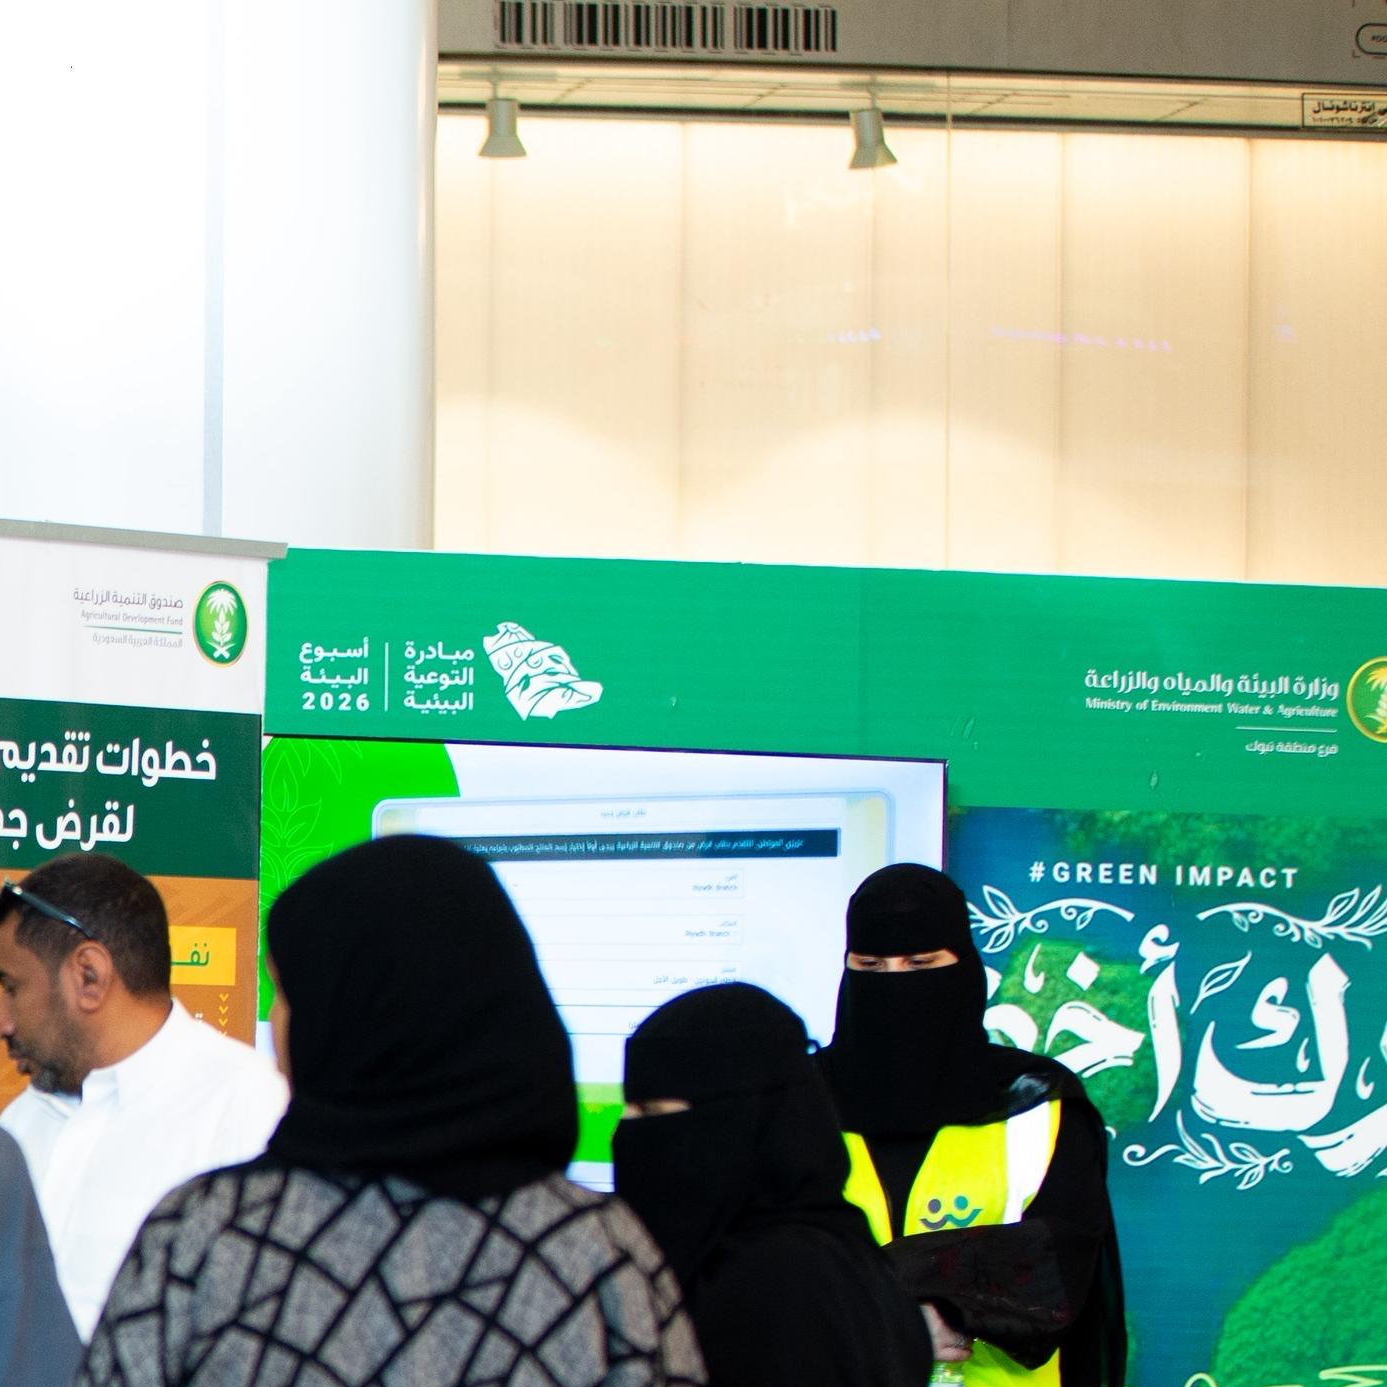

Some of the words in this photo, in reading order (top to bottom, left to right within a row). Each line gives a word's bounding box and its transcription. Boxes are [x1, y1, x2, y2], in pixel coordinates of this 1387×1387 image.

[74, 588, 111, 605] الزراعية
[113, 591, 147, 608] التنمية
[149, 594, 183, 609] صندوق
[299, 637, 369, 663] أسبوع
[404, 640, 474, 665] مبادرة
[299, 666, 368, 688] البيئة
[403, 665, 474, 690] التوعية
[1084, 669, 1159, 693] والزراعة
[1163, 672, 1234, 697] والمياه
[1237, 673, 1289, 699] البيئة
[1293, 676, 1340, 701] وزارة
[302, 692, 370, 712] 2026
[403, 691, 474, 714] البيئية
[1086, 697, 1132, 713] Ministry
[1136, 699, 1149, 711] of
[1151, 700, 1223, 714] Environment
[1227, 702, 1260, 715] Water
[1263, 704, 1273, 715] &
[1278, 704, 1338, 718] Agriculture
[96, 737, 218, 788] خطوات
[36, 800, 134, 851] لقرض
[1029, 861, 1158, 885] #GREEN
[1176, 864, 1299, 889] IMPACT
